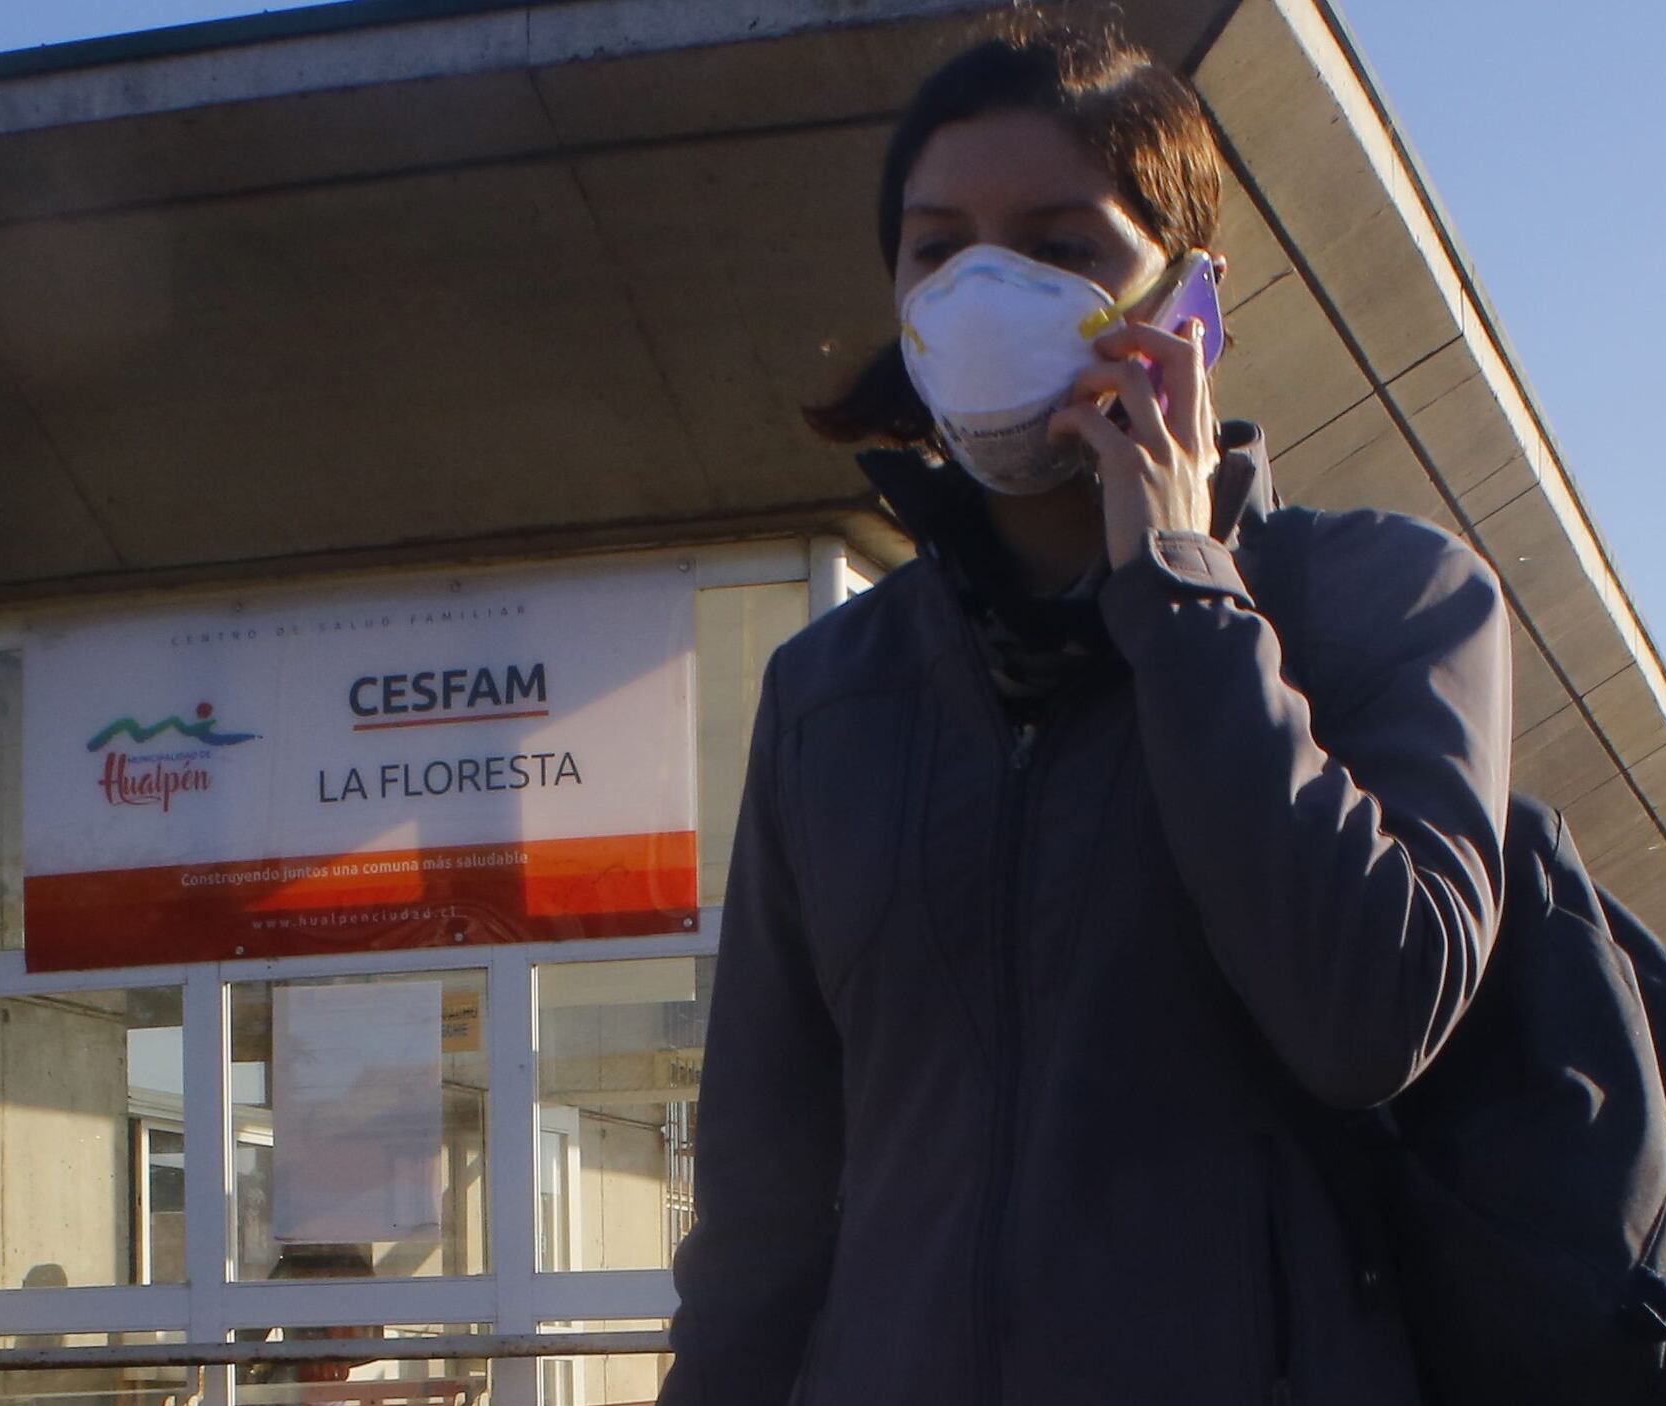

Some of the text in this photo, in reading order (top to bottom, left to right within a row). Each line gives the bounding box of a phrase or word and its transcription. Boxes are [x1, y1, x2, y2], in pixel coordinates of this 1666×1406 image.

[170, 629, 258, 647] CENTRO
[317, 617, 391, 634] SALUD
[408, 606, 525, 625] FAMILIAR
[349, 662, 547, 717] CESFAM
[98, 752, 211, 813] Hualpén
[318, 751, 582, 803] LA FLORESTA
[180, 850, 530, 888] Construyendo juntos una comuna más saludable
[252, 905, 456, 930] www.hualpenciudad.cl
